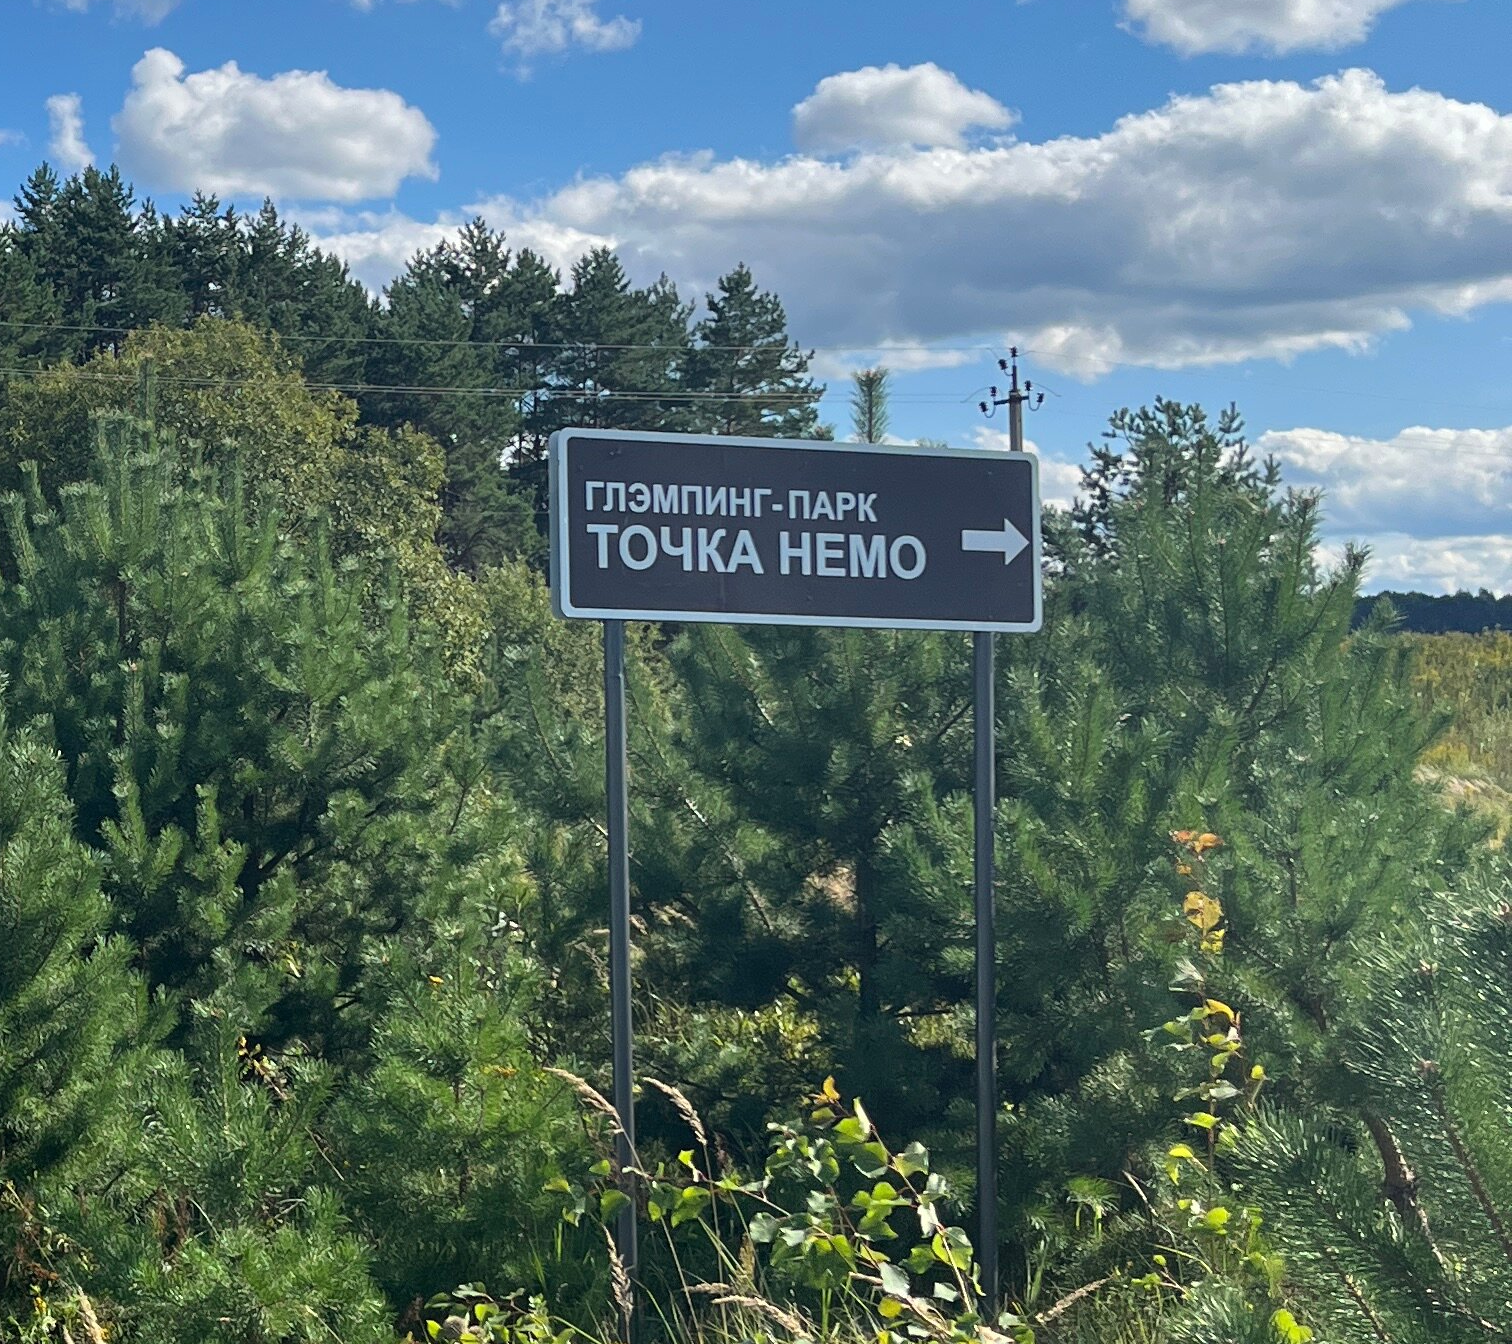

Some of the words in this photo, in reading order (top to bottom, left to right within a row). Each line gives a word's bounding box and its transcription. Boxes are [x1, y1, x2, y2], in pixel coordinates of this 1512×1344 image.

[585, 481, 877, 522] ГЛЭМПИНГ-ПАРК
[586, 523, 764, 575] ТОЧКА
[779, 531, 926, 580] НЕМО
